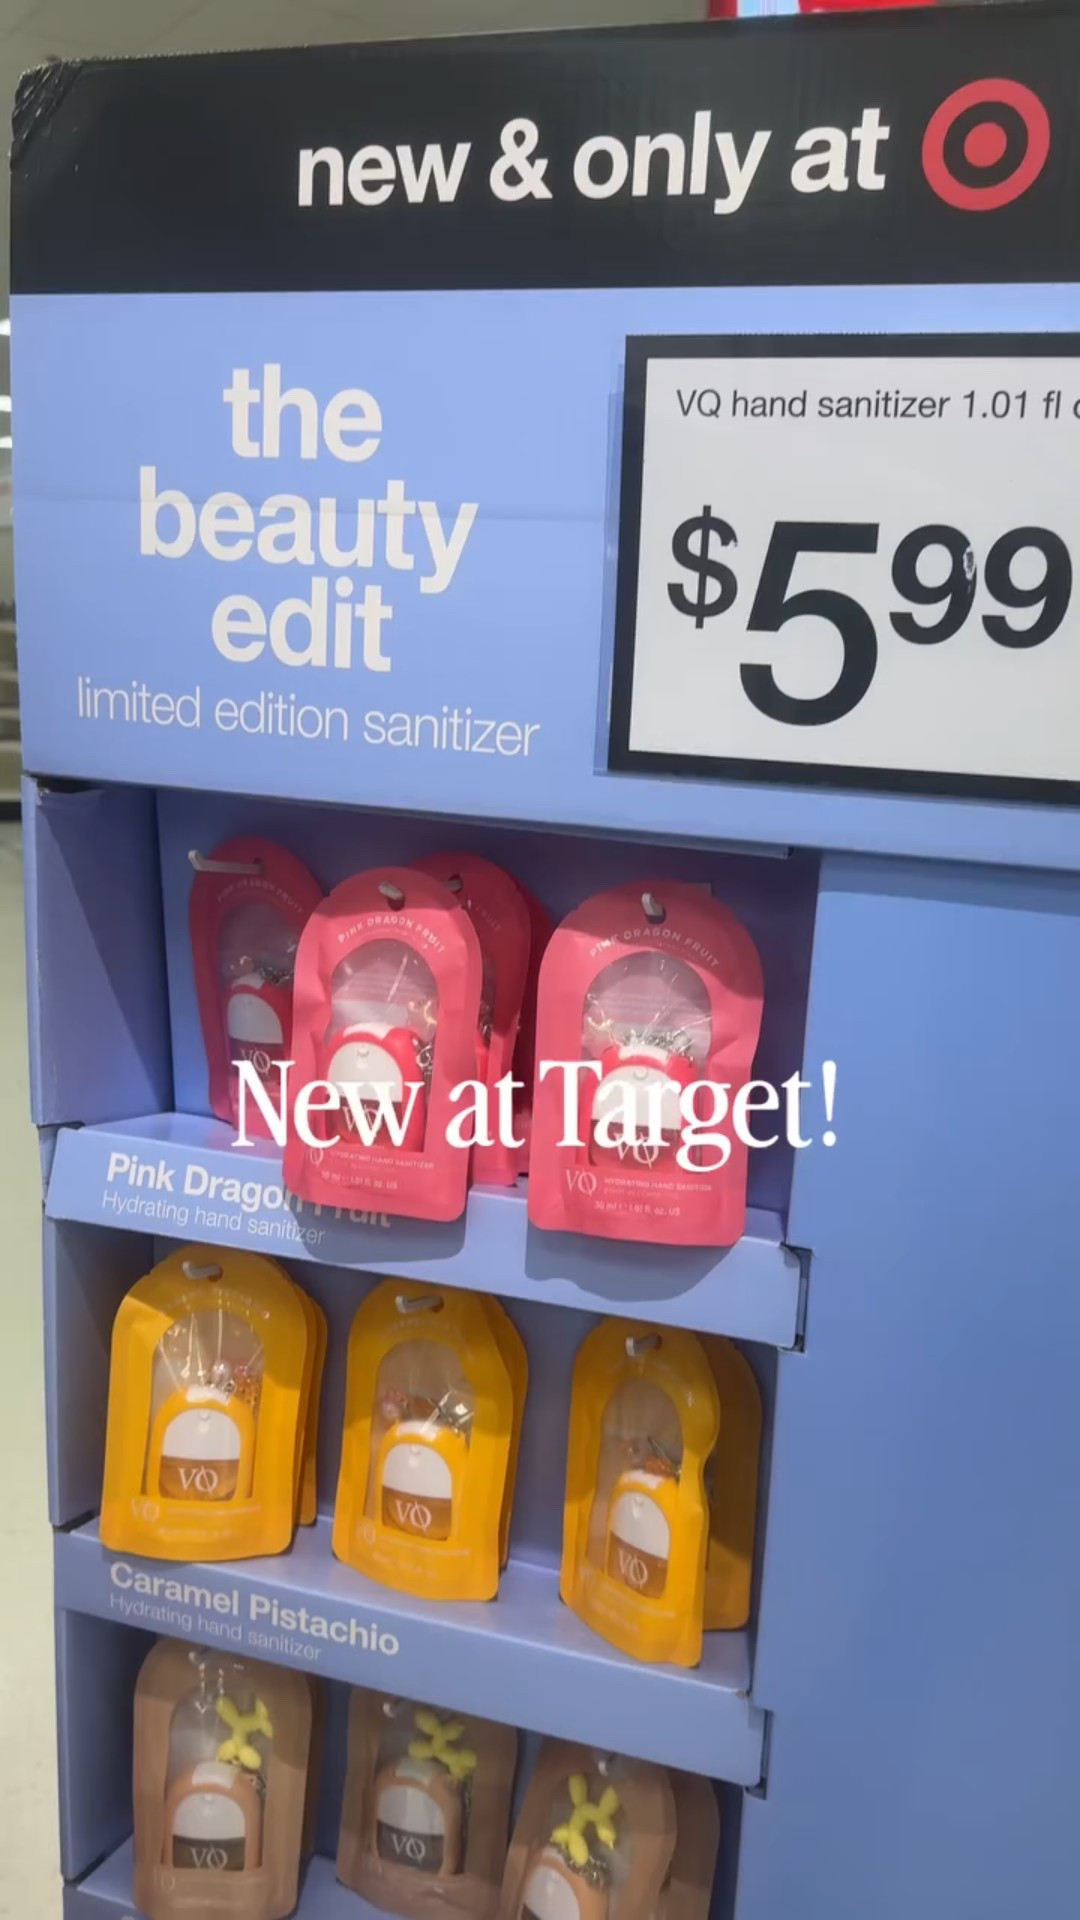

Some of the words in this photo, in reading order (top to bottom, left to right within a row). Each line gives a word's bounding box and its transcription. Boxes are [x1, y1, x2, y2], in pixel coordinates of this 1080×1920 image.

[298, 142, 472, 207] new
[489, 117, 553, 202] &
[573, 109, 772, 215] only
[790, 107, 891, 194] at
[222, 362, 383, 463] the
[676, 389, 722, 419] VQ
[731, 389, 808, 419] hand
[817, 389, 952, 419] sanitizer
[962, 389, 1028, 419] 1.01
[1042, 389, 1063, 419] fl
[139, 465, 480, 595] beauty
[211, 578, 393, 673] edit
[78, 676, 200, 728] limited
[214, 691, 350, 741] edition
[363, 705, 541, 756] sanitizer
[367, 915, 413, 930] DRAGON
[624, 927, 682, 943] DRAGON
[685, 937, 720, 968] FRUIT
[106, 1151, 176, 1192] Pink
[184, 1163, 302, 1212] Dragon
[101, 1189, 190, 1227] Hydrating
[194, 1206, 242, 1231] hand
[247, 1214, 327, 1246] sanitizer
[177, 1464, 219, 1495] VQ
[394, 1498, 433, 1533] VQ
[617, 1548, 649, 1589] VQ
[110, 1560, 239, 1617] Caramel
[250, 1594, 400, 1656] Pistachio
[110, 1593, 193, 1632] Hydrating
[197, 1614, 242, 1641] hand
[247, 1629, 323, 1661] sanitizer
